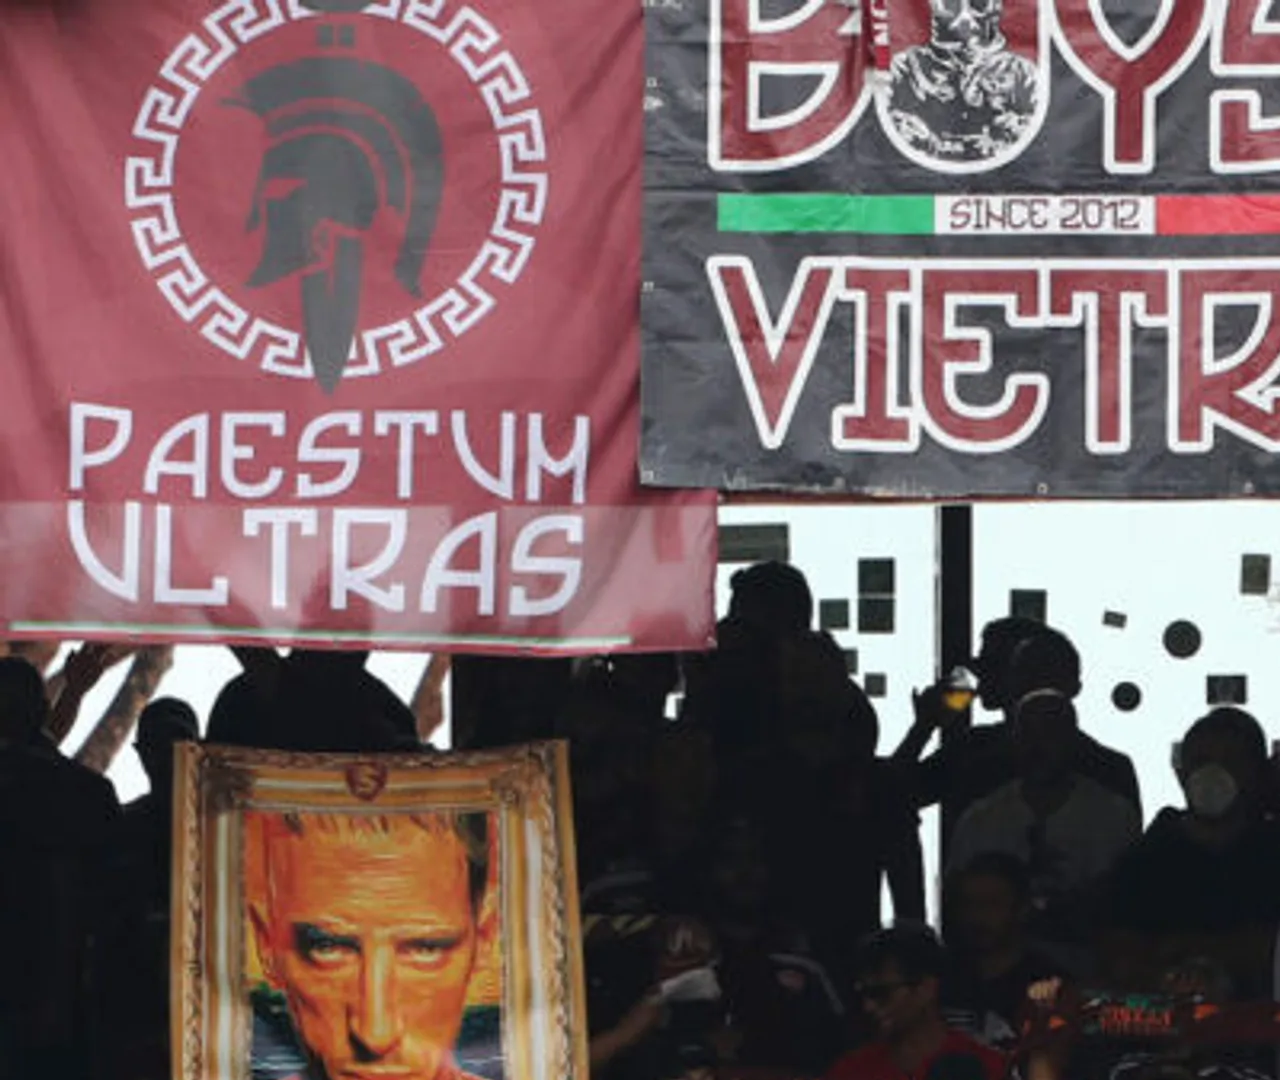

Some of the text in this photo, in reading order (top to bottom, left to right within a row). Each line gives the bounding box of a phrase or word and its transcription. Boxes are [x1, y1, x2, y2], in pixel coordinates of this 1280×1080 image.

[950, 199, 1141, 230] SINCE 2012
[67, 502, 585, 616] ULTRAS
